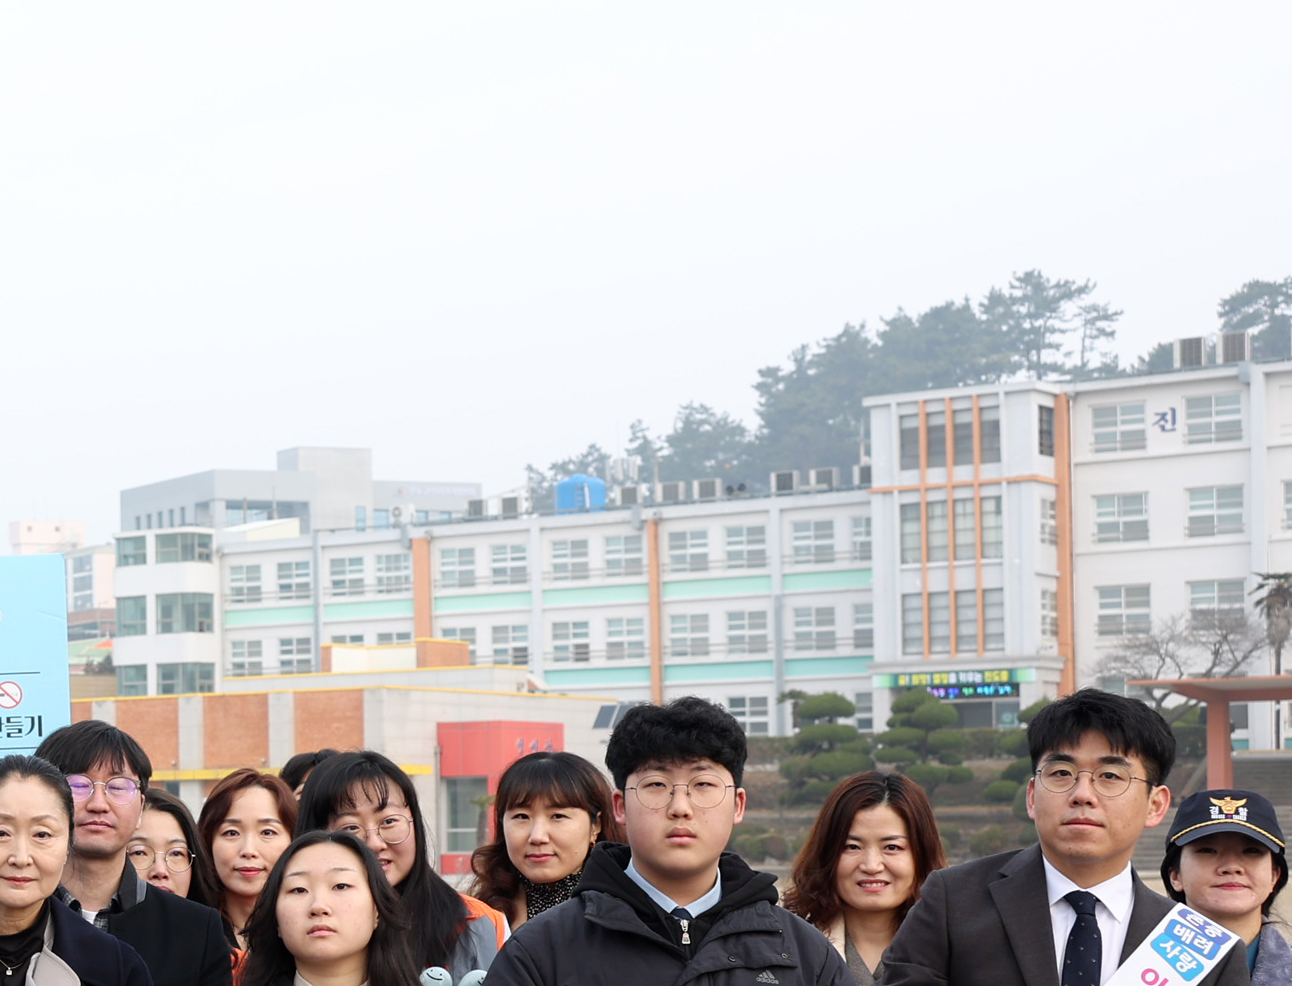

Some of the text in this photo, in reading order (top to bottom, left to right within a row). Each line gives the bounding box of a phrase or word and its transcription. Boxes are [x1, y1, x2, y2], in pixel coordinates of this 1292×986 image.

[1153, 406, 1177, 433] 진
[1173, 924, 1213, 955] 배려
[1159, 938, 1199, 974] 사랑
[756, 977, 779, 985] adidas
